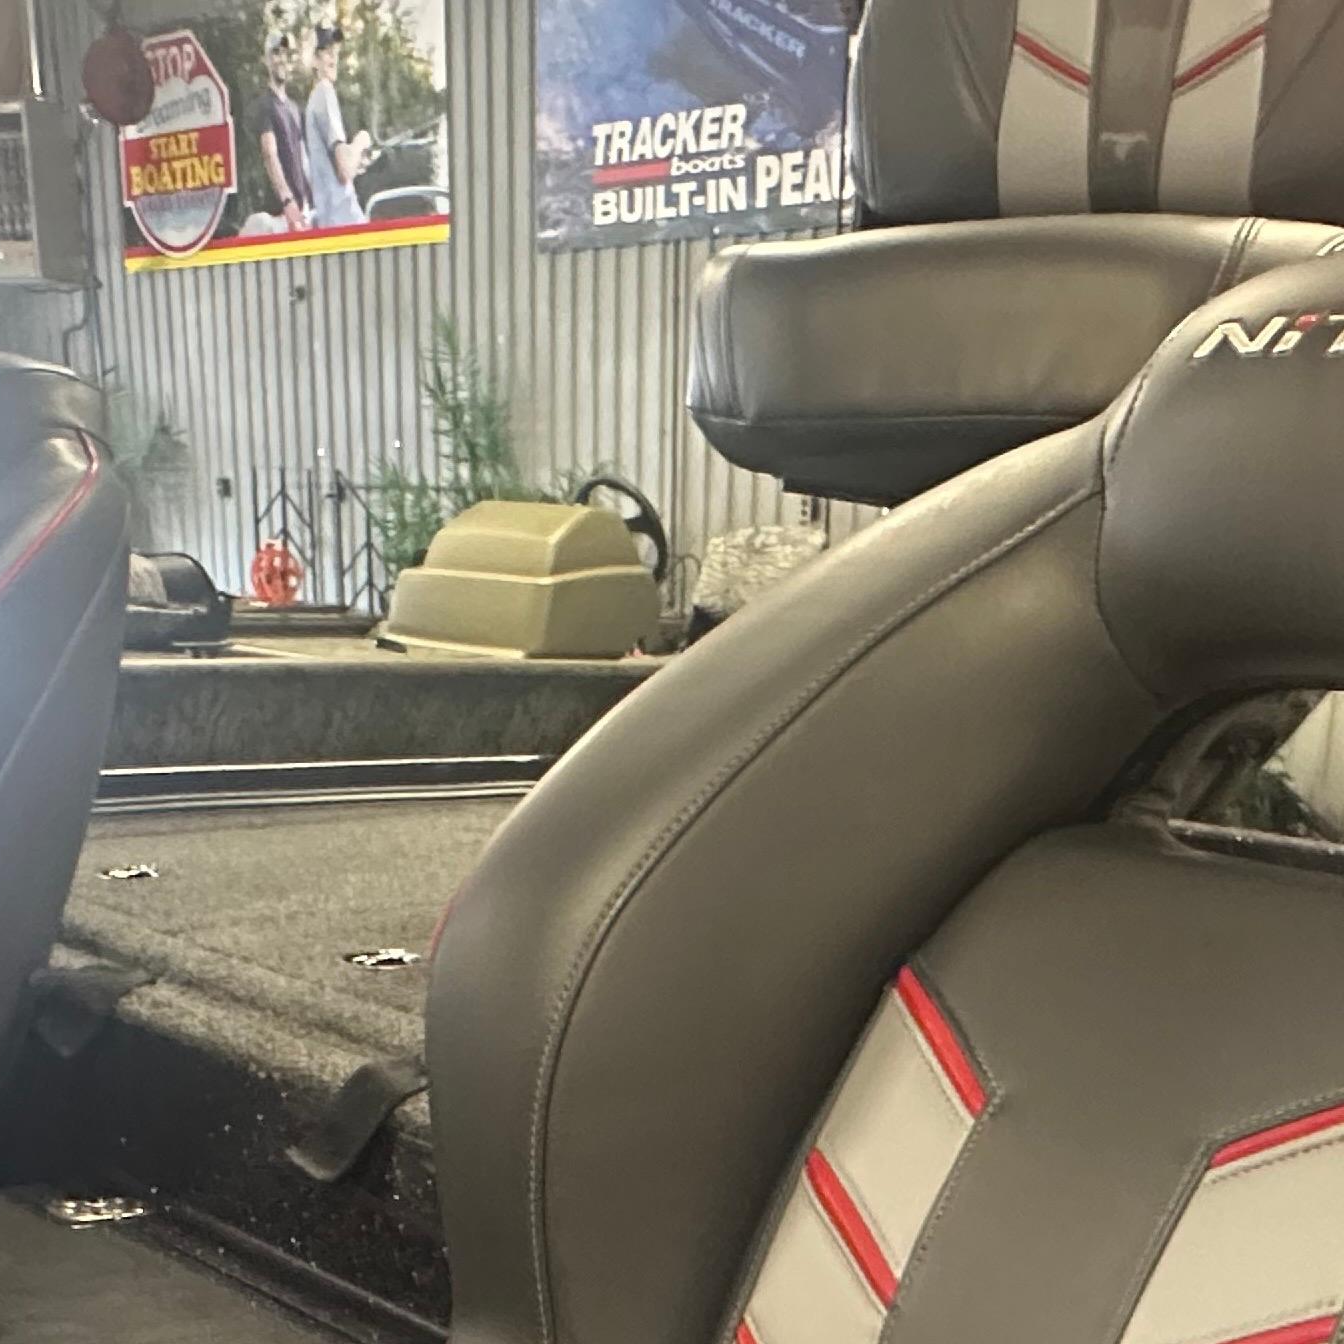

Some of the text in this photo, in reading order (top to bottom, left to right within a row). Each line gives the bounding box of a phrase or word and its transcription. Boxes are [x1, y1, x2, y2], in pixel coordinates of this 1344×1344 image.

[149, 131, 200, 159] START
[591, 103, 747, 167] TRACKER
[129, 152, 225, 197] BOATING
[670, 152, 746, 177] boats
[592, 175, 748, 226] BUILT-IN
